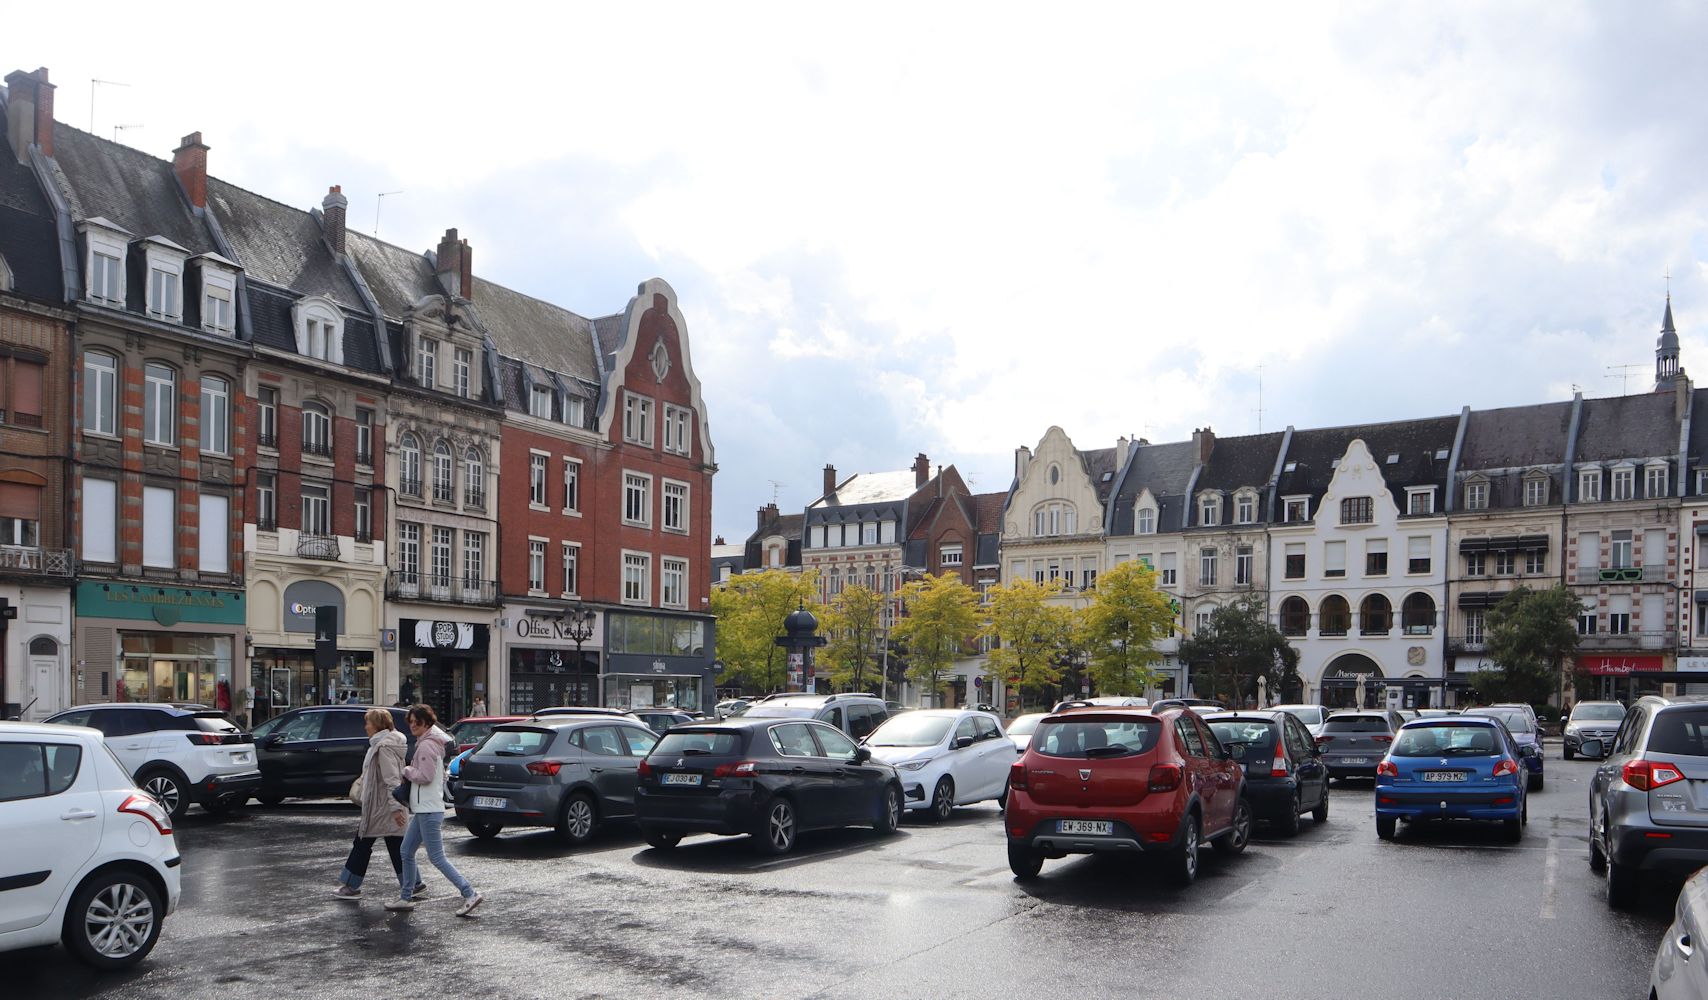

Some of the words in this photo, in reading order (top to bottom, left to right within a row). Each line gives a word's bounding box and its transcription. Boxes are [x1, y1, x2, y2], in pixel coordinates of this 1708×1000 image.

[438, 623, 452, 632] POP
[517, 618, 550, 638] Office
[436, 631, 455, 641] STUDIO
[1334, 669, 1375, 678] Marioaud
[1062, 821, 1107, 833] EW-369-NX
